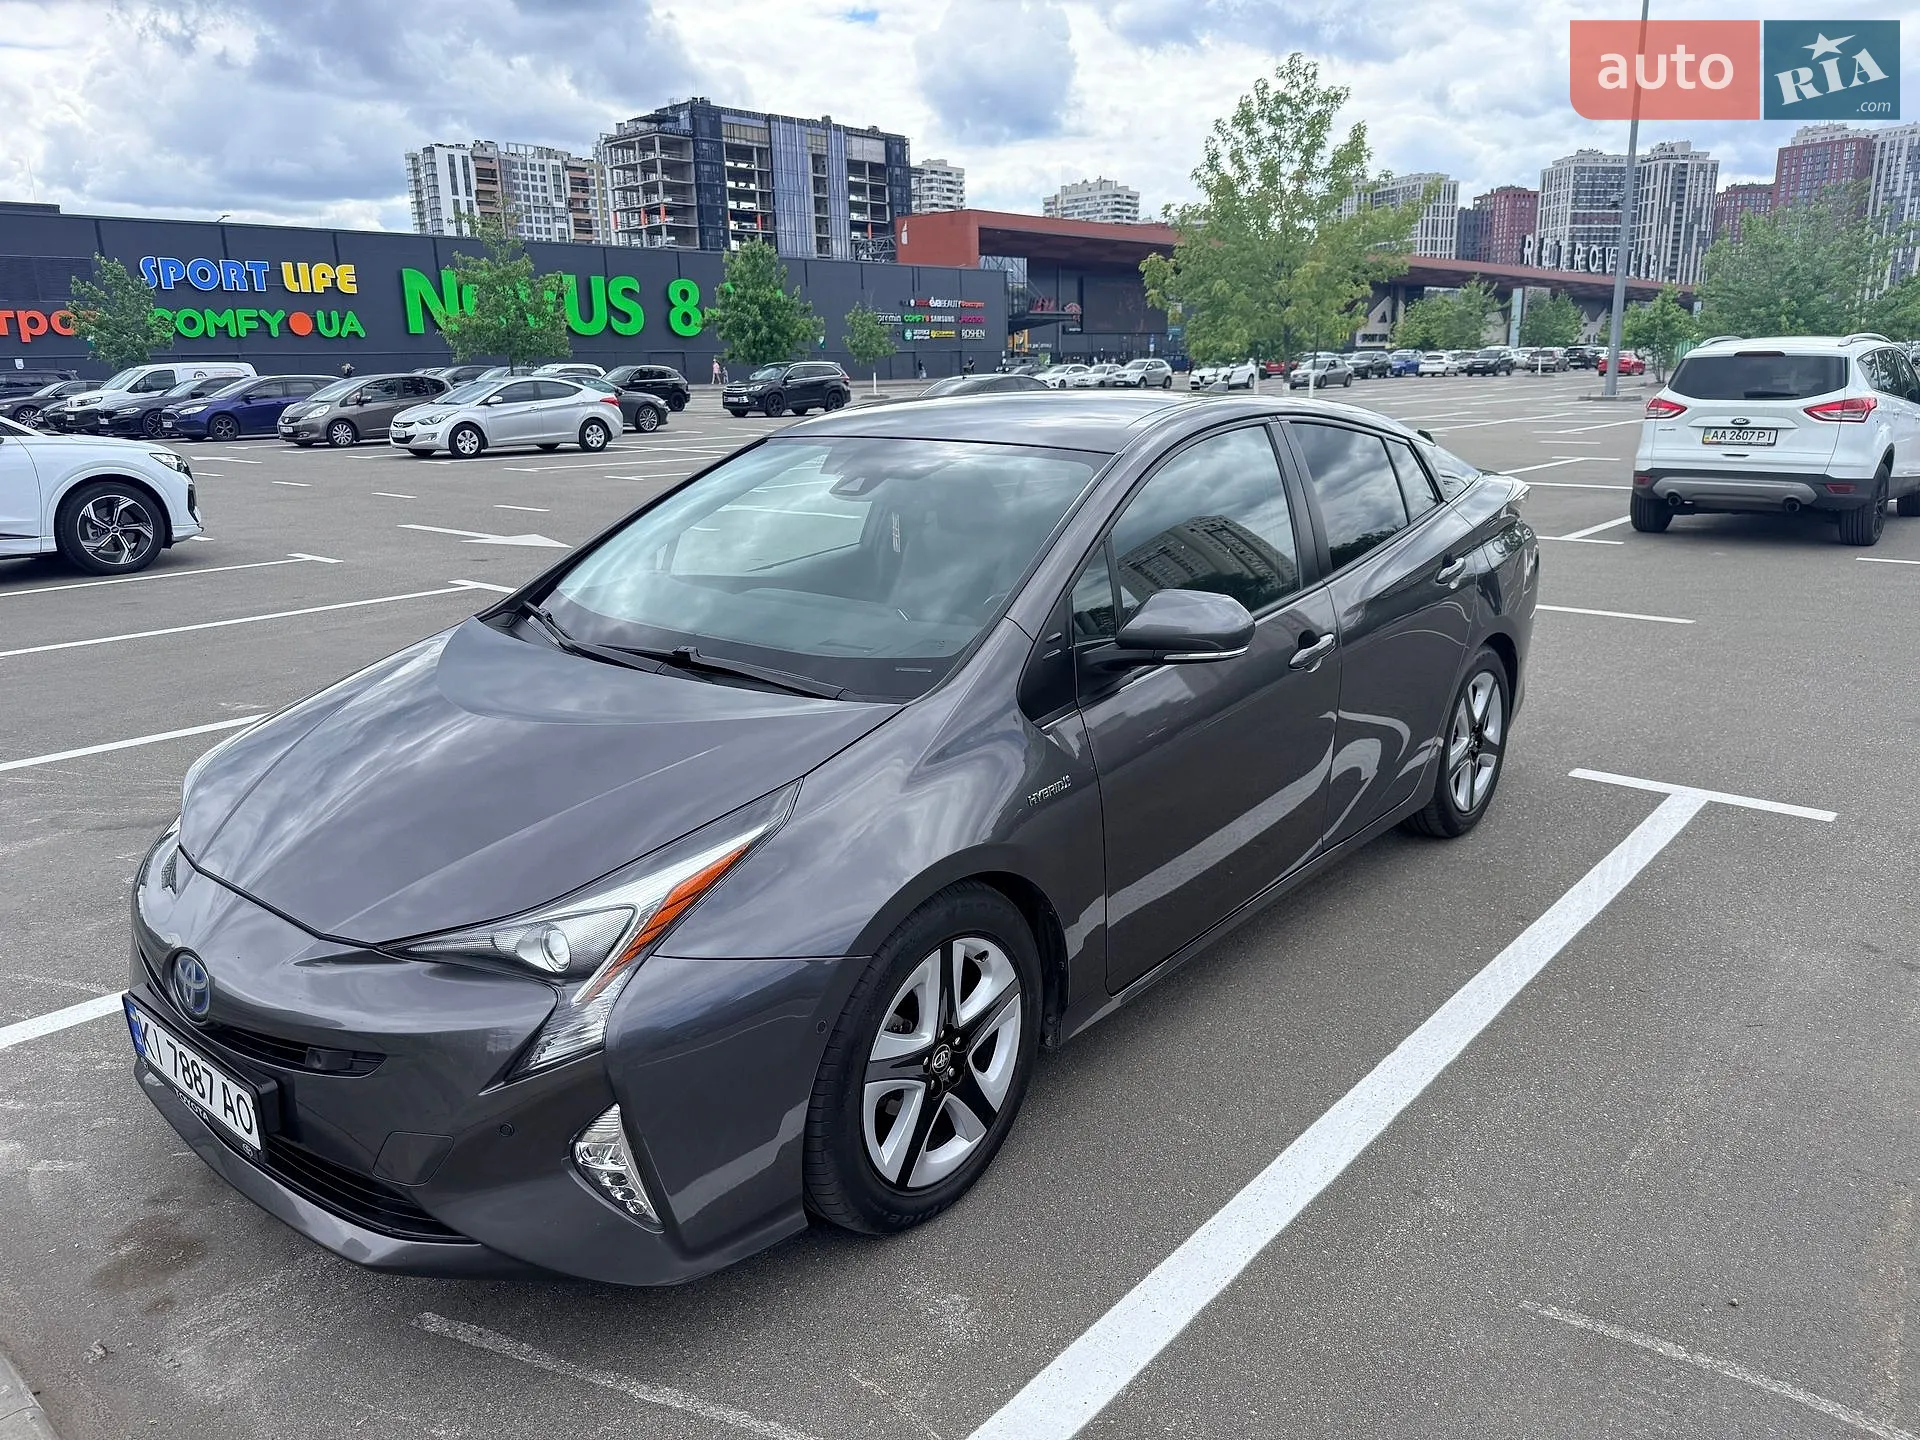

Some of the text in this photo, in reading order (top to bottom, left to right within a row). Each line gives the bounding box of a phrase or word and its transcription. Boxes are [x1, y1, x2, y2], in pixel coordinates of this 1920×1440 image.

[139, 255, 359, 295] SPORT LIFE
[1523, 234, 1657, 281] RETROVLLE
[402, 268, 702, 337] NUS 8
[961, 329, 986, 339] ROSHEN
[1711, 430, 1727, 441] AA
[1729, 430, 1755, 441] 2607
[1028, 779, 1064, 807] HYBRID
[137, 1015, 253, 1135] KI 7887 AO
[174, 1088, 211, 1124] TOYOTA
